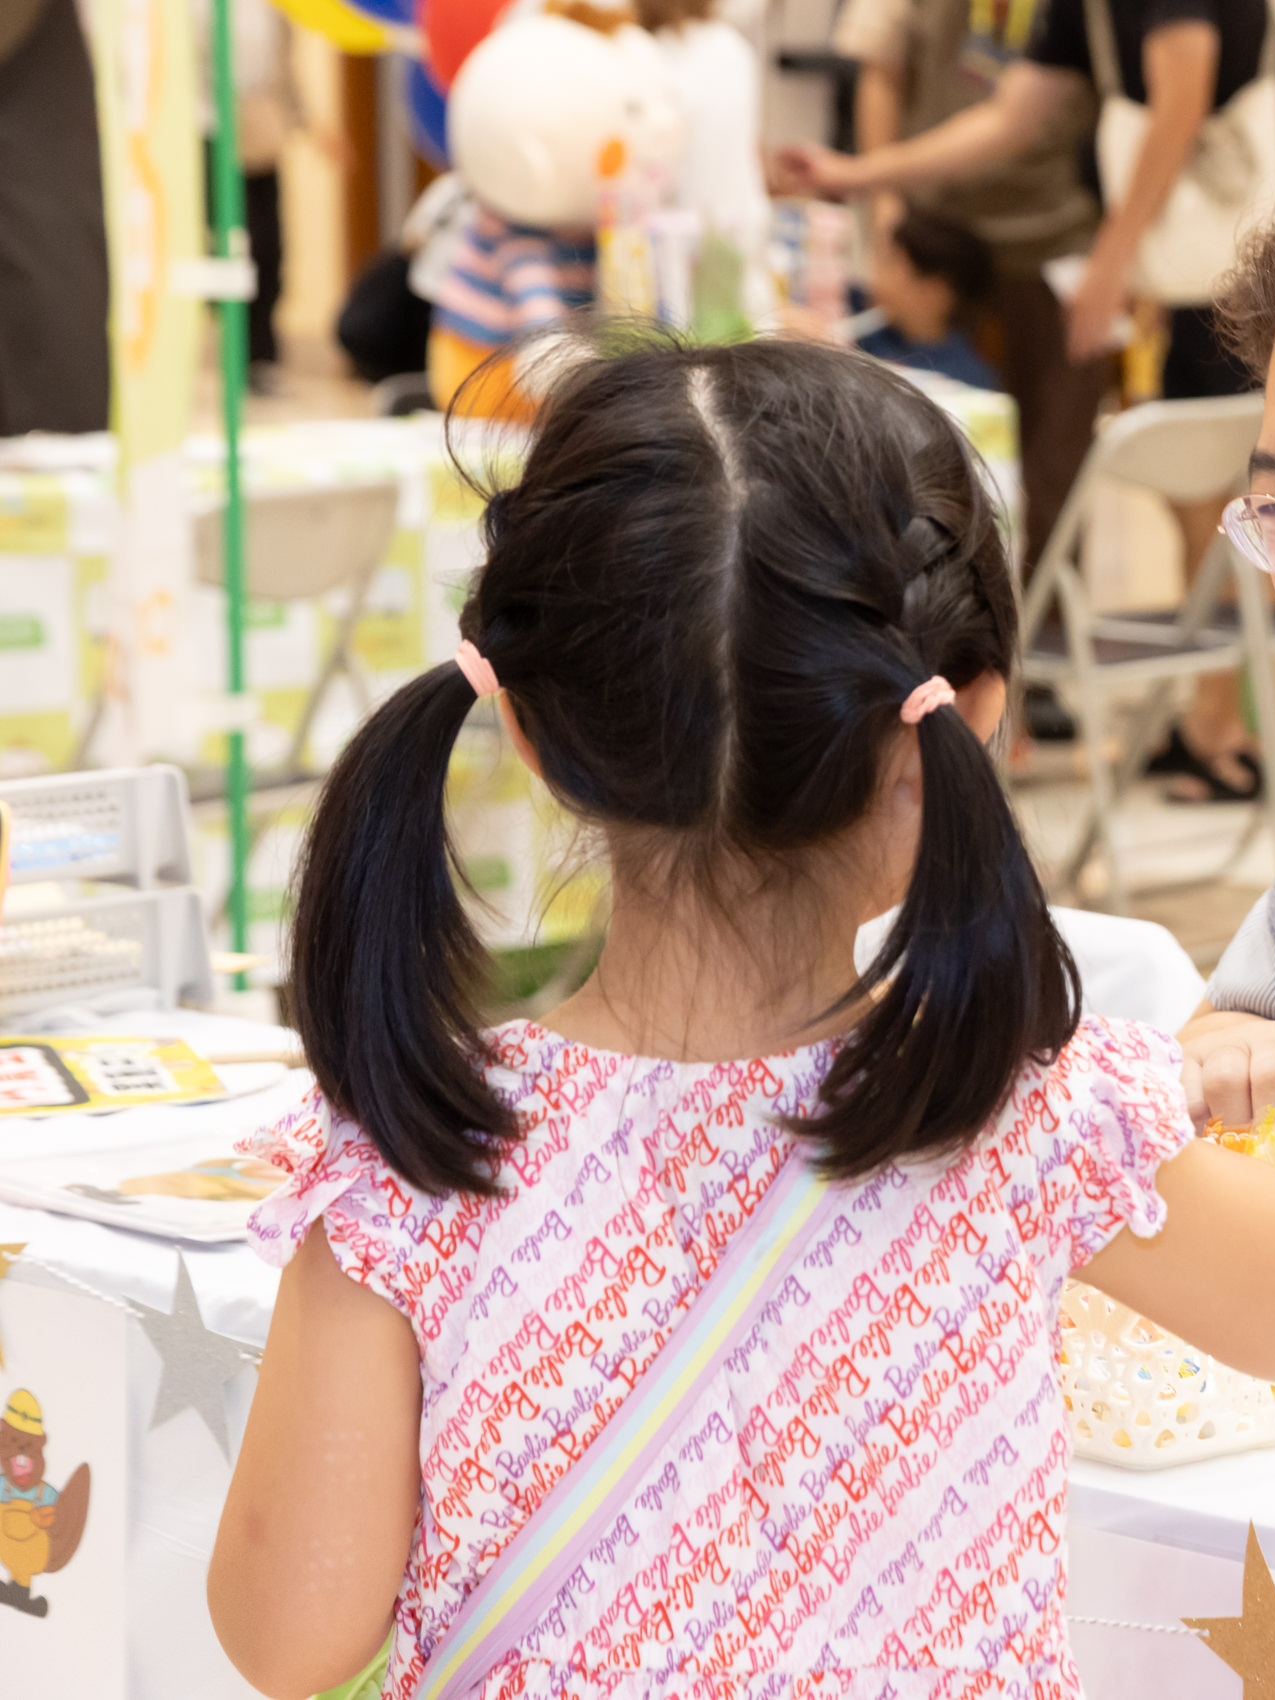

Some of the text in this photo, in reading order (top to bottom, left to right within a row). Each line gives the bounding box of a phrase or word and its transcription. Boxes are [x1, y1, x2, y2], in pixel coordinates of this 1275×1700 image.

[707, 1058, 783, 1128] Barbie
[719, 1124, 783, 1181] Barbie
[511, 1210, 572, 1263] Barbie
[803, 1214, 862, 1269] Barbie
[874, 1202, 946, 1276] Barbie
[914, 1211, 988, 1285] Barbie
[544, 1237, 623, 1313] Barbie
[586, 1245, 666, 1323] Barbie
[810, 1272, 890, 1347] Barbie
[481, 1311, 561, 1380] Barbie
[523, 1321, 603, 1388] Barbie
[590, 1329, 654, 1382] Barbie
[852, 1283, 932, 1360] Barbie
[938, 1300, 1018, 1373] Barbie
[542, 1381, 604, 1437] Barbie
[802, 1354, 870, 1420] Barbie
[880, 1367, 957, 1446] Barbie
[963, 1434, 1019, 1485] Barbie
[781, 1500, 848, 1575] Barbie
[815, 1509, 883, 1585] Barbie
[955, 1502, 1024, 1571] Barbie
[737, 1568, 799, 1640] Barbie
[764, 1582, 832, 1653] Barbie
[933, 1580, 997, 1650] Barbie
